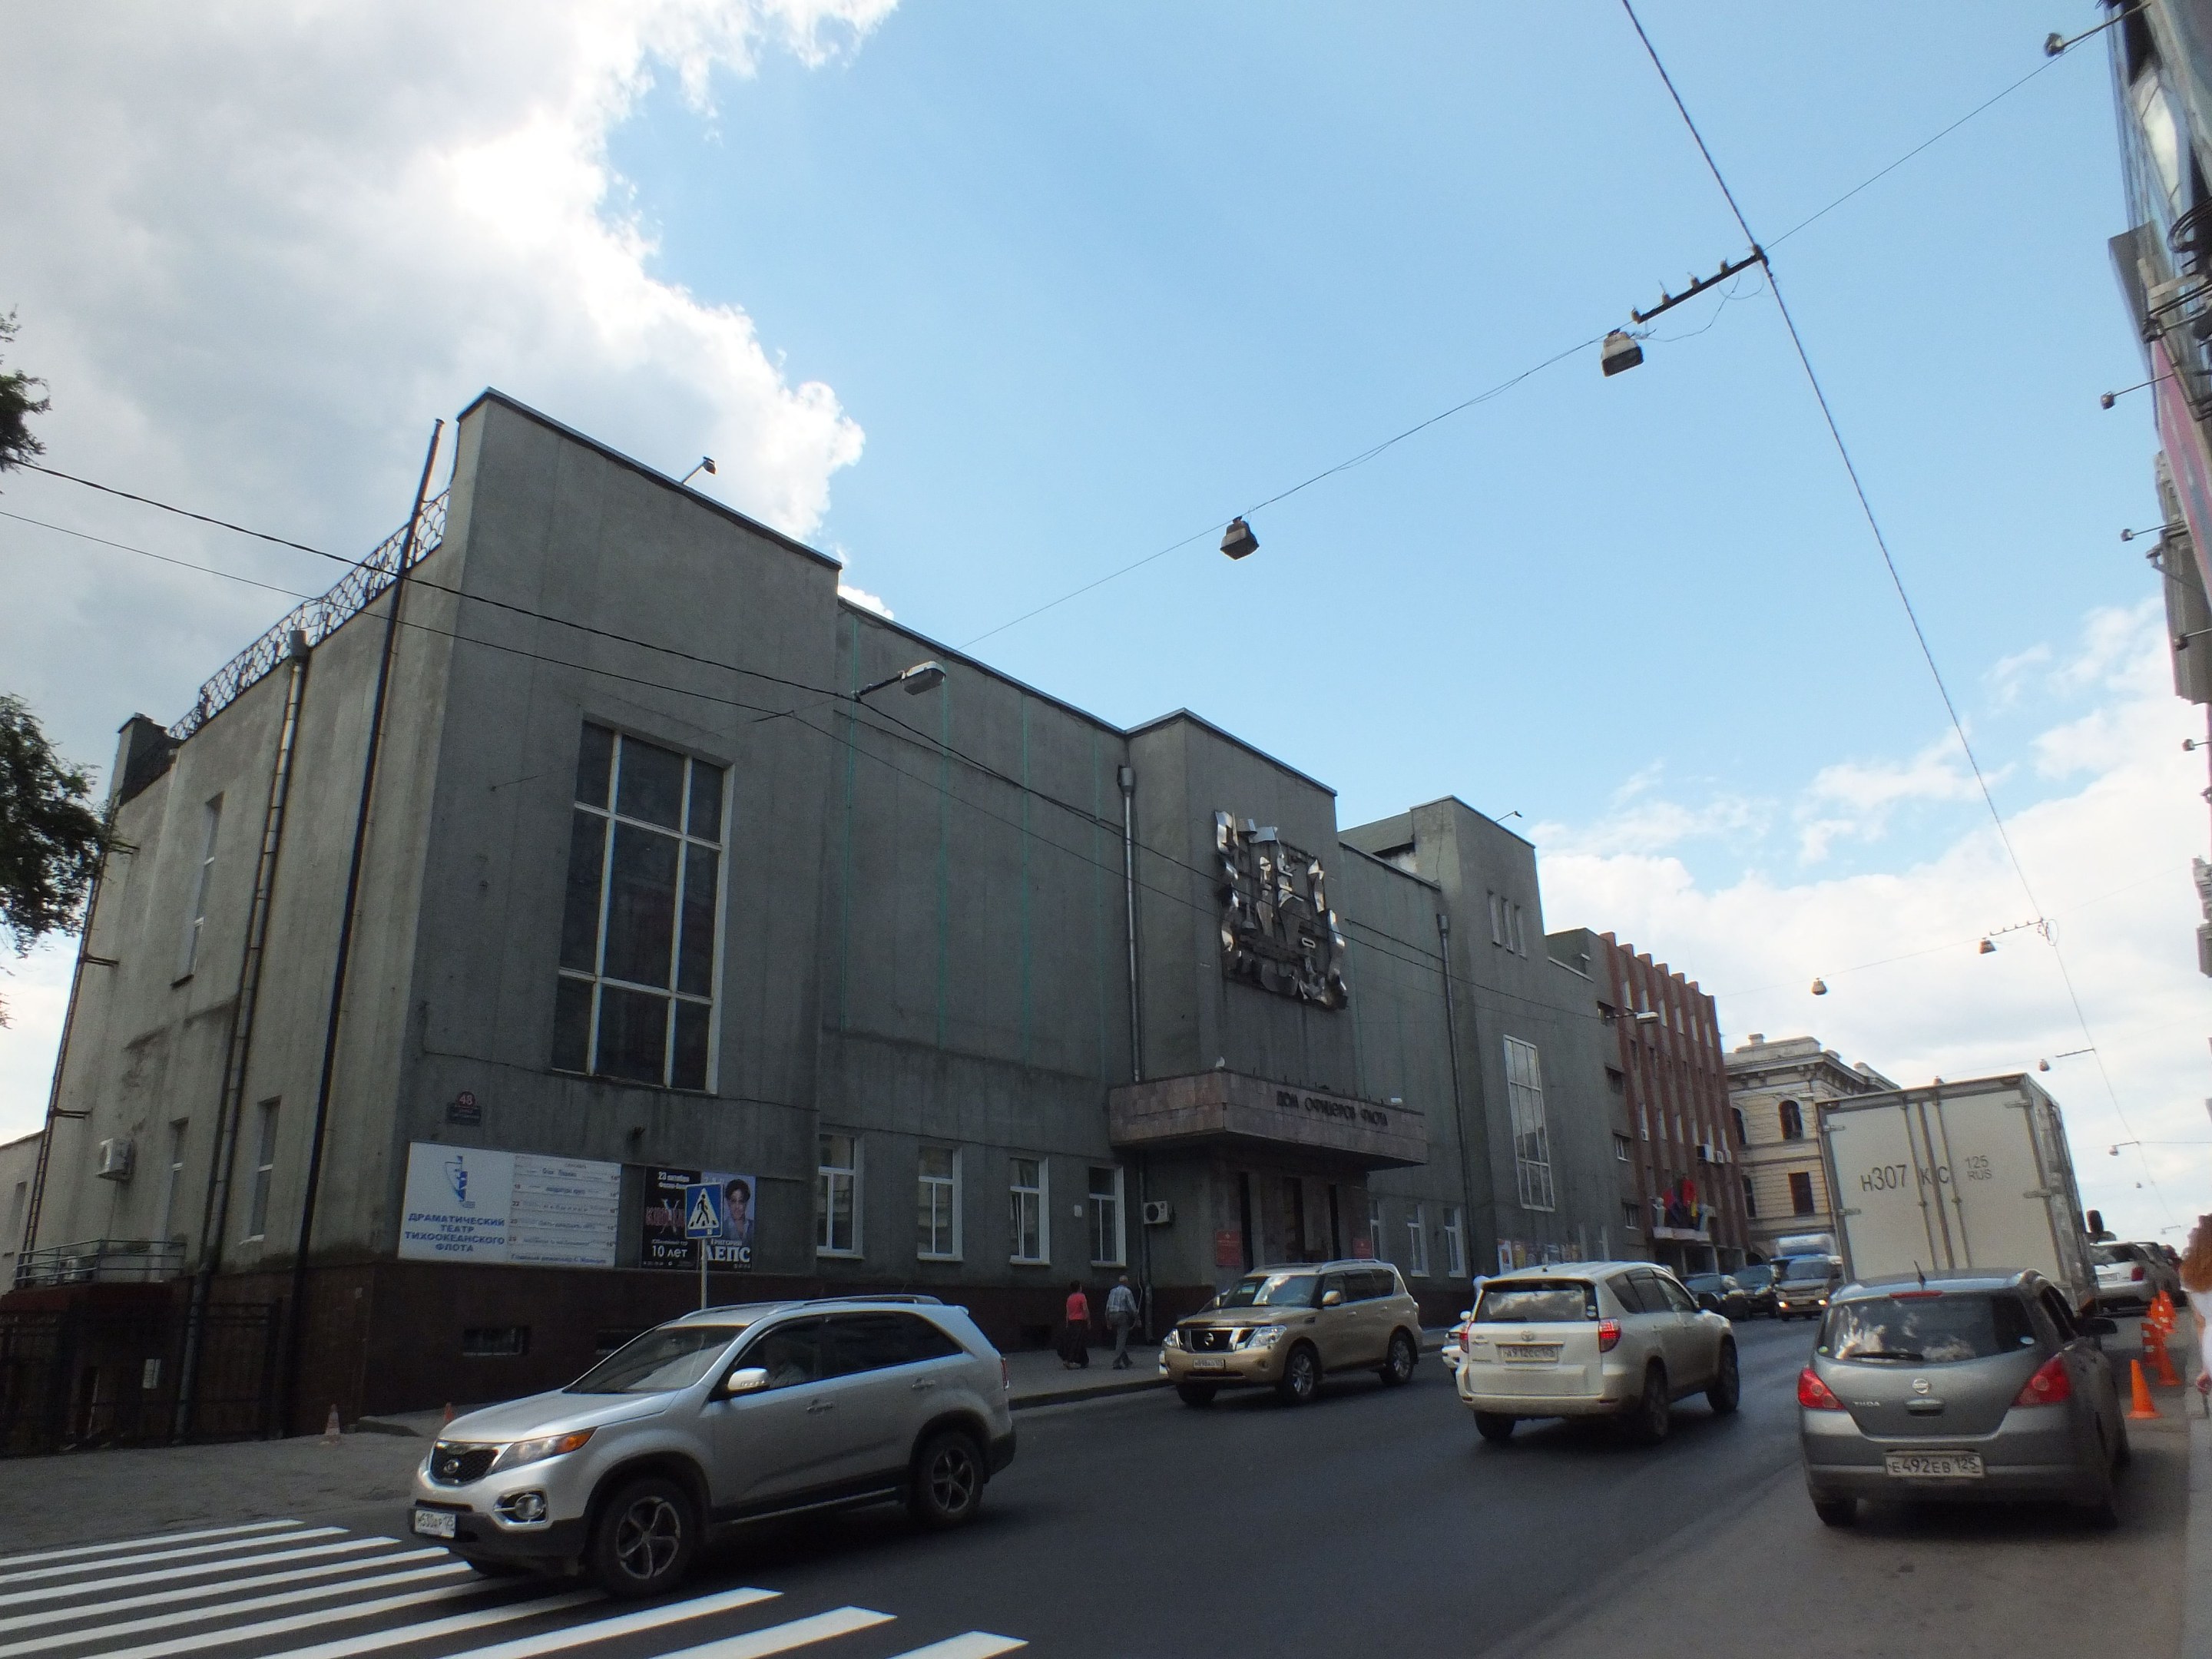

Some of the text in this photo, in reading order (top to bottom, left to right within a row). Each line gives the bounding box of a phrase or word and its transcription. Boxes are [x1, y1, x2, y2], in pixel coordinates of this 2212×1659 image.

[1965, 1155, 1989, 1168] 125
[1967, 1169, 1992, 1181] RUS
[408, 1213, 505, 1227] ДРАМАТИЧЕСКИЙ
[440, 1224, 475, 1233] ТЕАТР
[405, 1231, 505, 1245] ТИХООКЕАНСКОГО
[435, 1243, 474, 1252] ФЛОТА
[652, 1245, 687, 1257] 10 лет
[1954, 1457, 1977, 1469] 125
